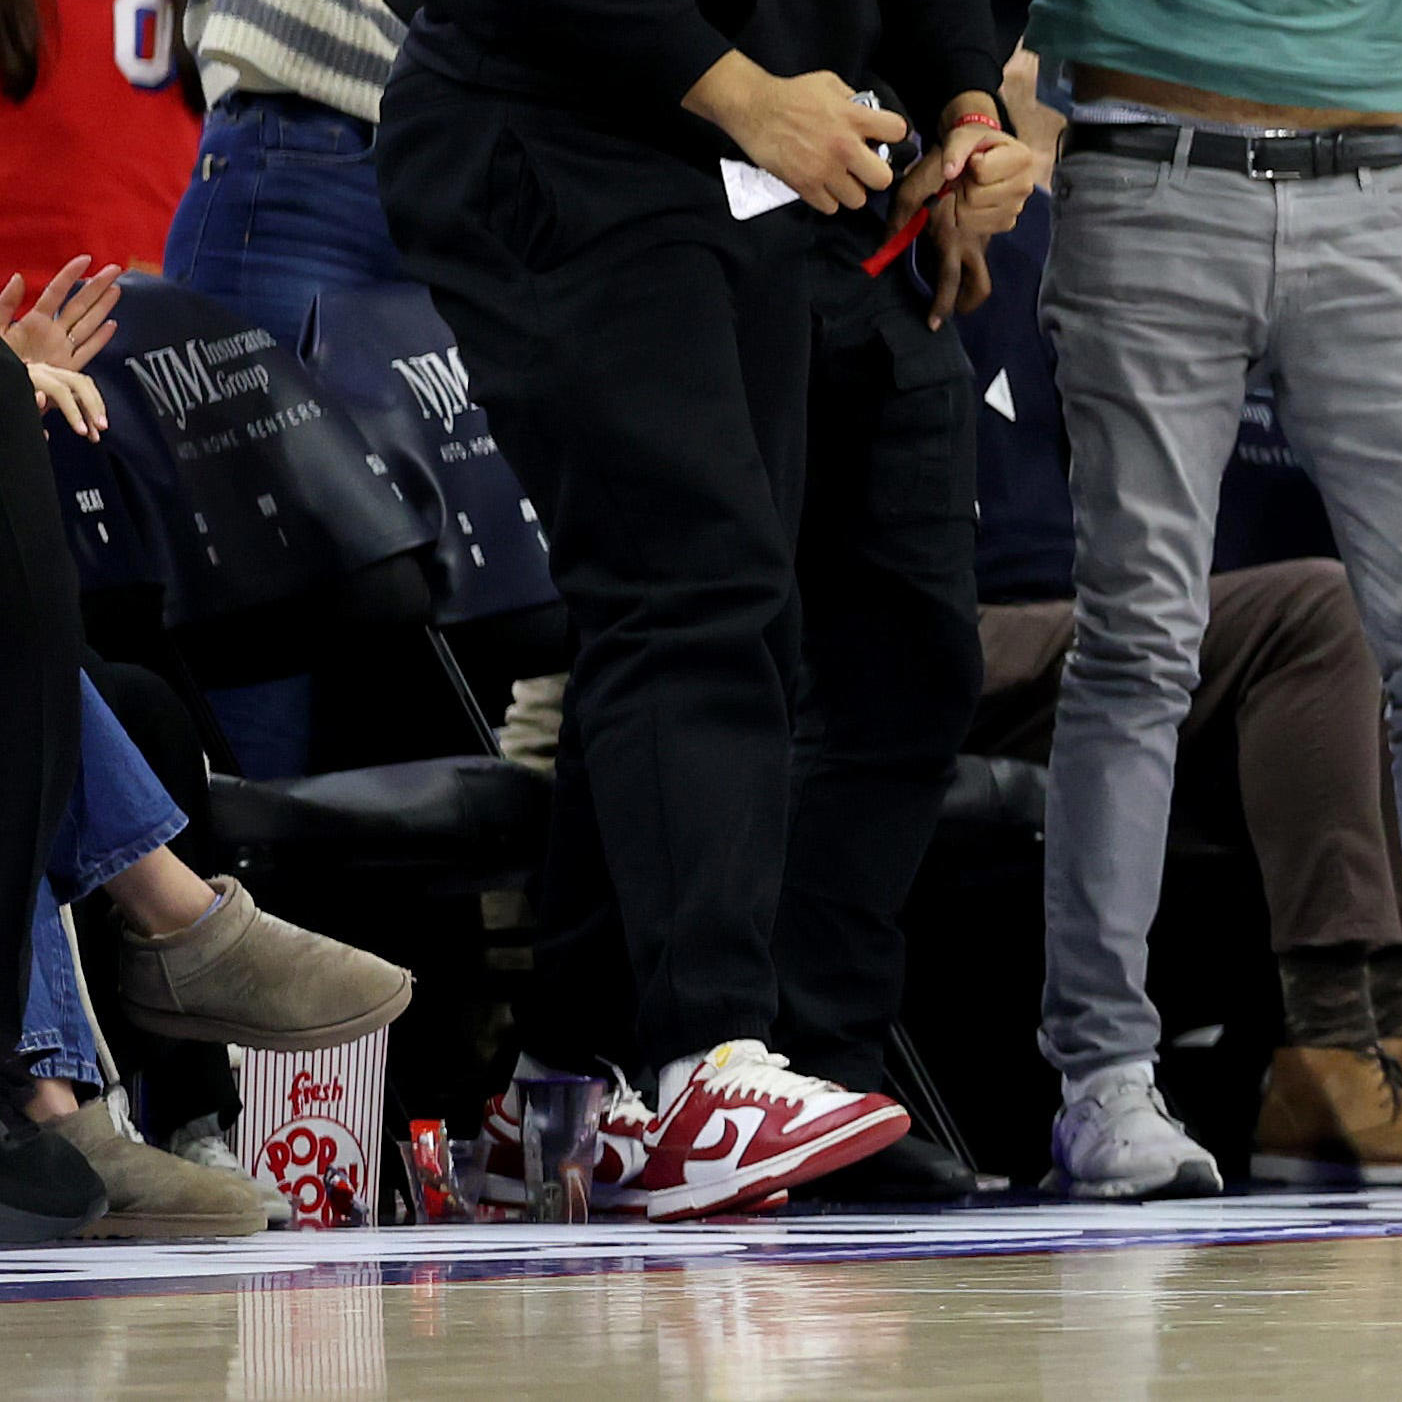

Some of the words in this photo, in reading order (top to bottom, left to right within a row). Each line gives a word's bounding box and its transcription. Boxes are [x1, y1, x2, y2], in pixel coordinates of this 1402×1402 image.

[124, 338, 222, 431] NJM
[215, 363, 270, 400] Group
[287, 1070, 344, 1117] fresh
[265, 1127, 338, 1183] POP
